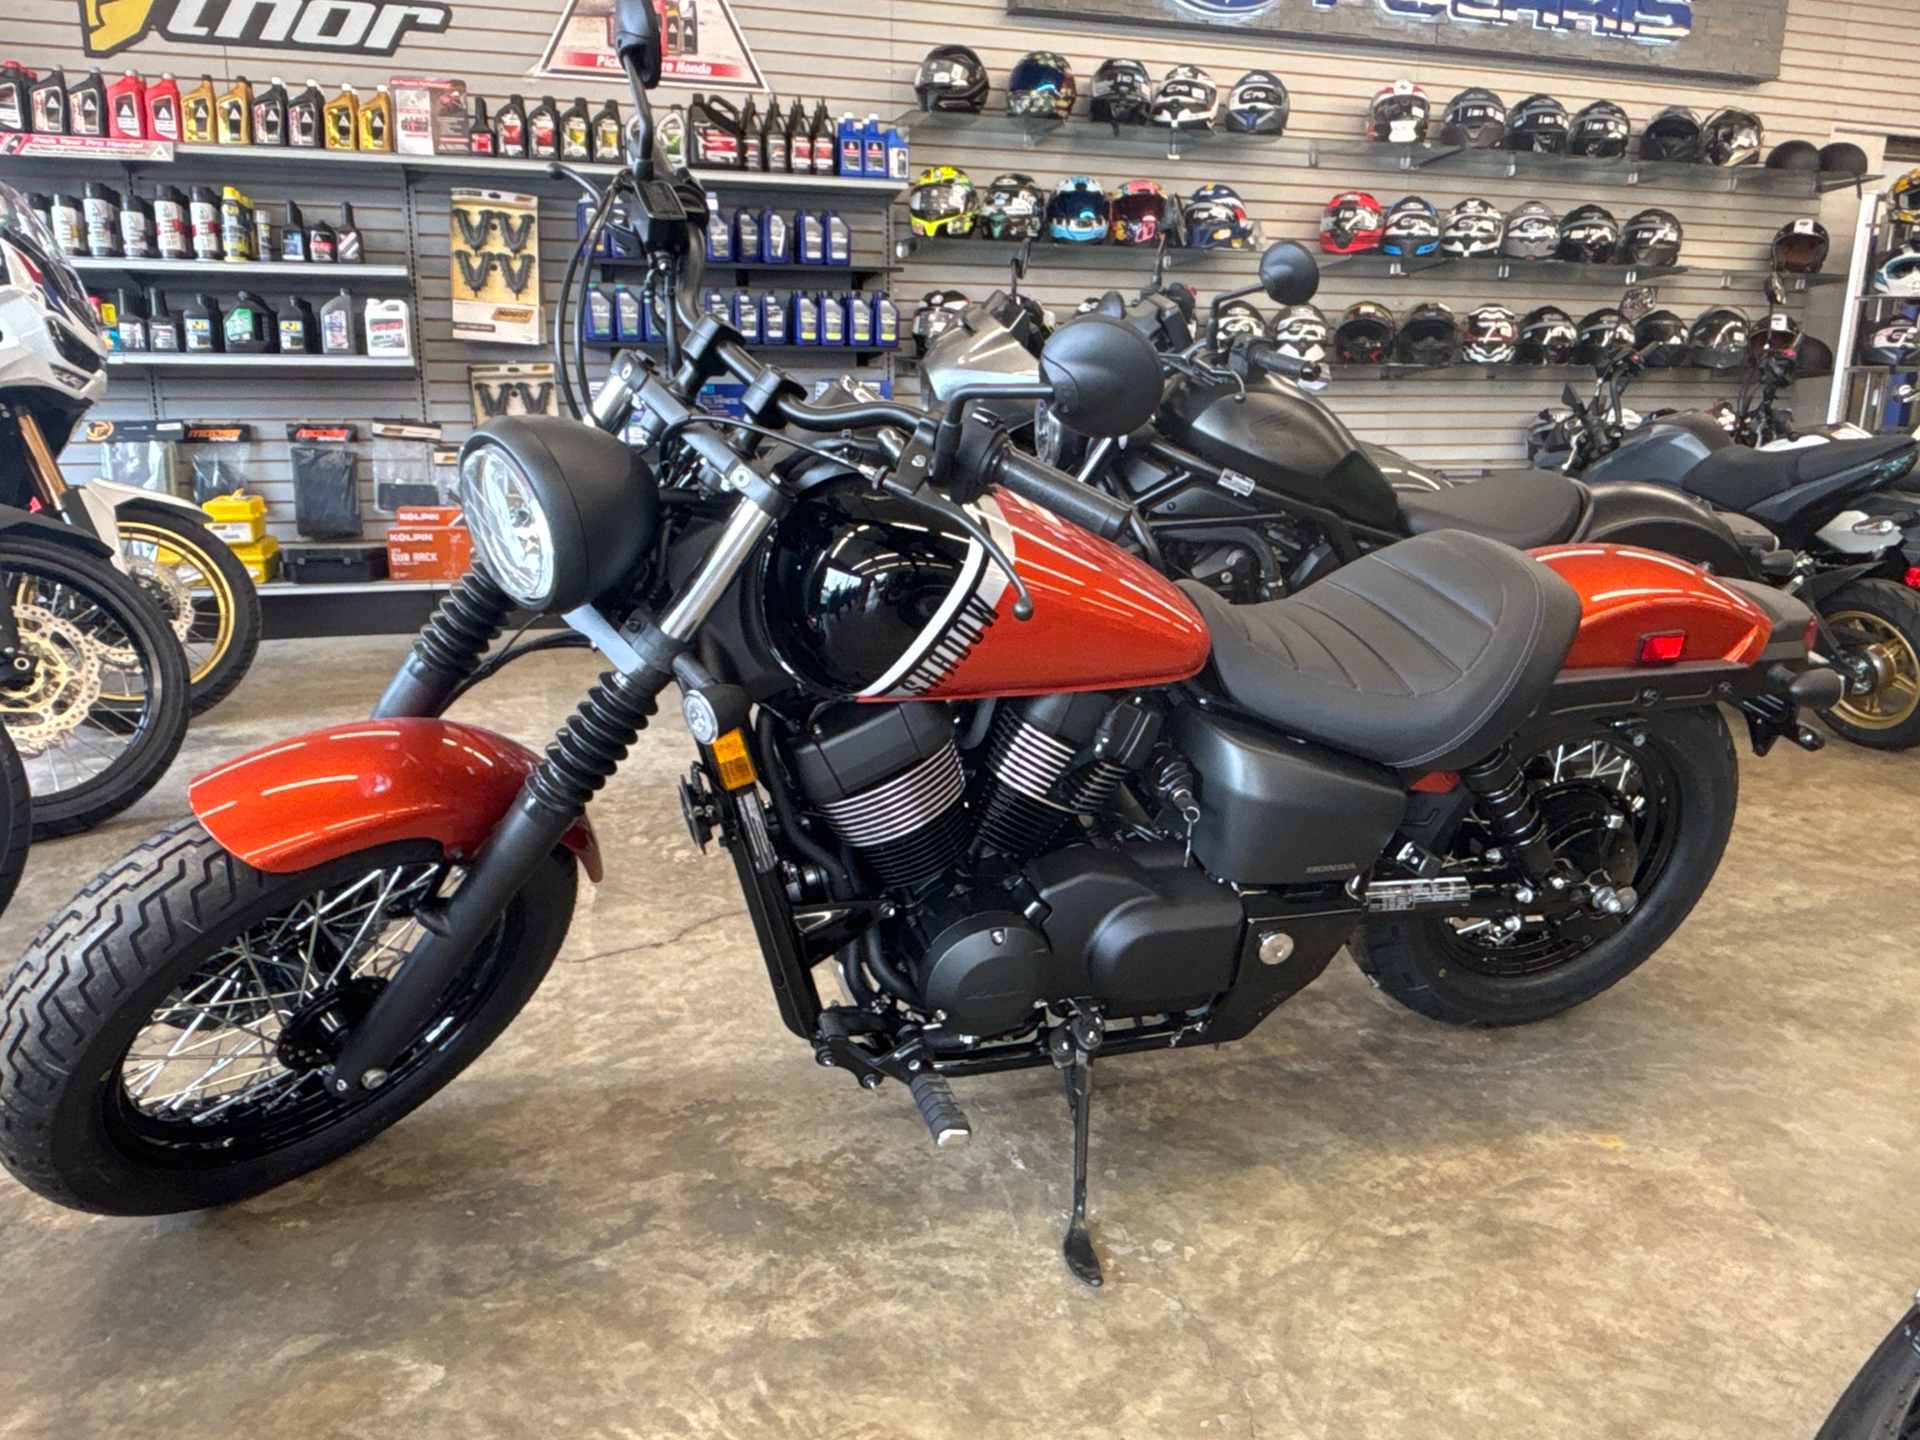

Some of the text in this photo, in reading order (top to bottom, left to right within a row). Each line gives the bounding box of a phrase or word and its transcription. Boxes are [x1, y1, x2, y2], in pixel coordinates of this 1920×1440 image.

[660, 59, 674, 72] ro
[676, 59, 713, 75] Honda
[399, 512, 439, 521] KOLPIN
[389, 532, 434, 542] KOLPIN
[412, 552, 438, 562] RACK
[900, 592, 999, 696] SHADOW
[1303, 862, 1357, 874] HONDA
